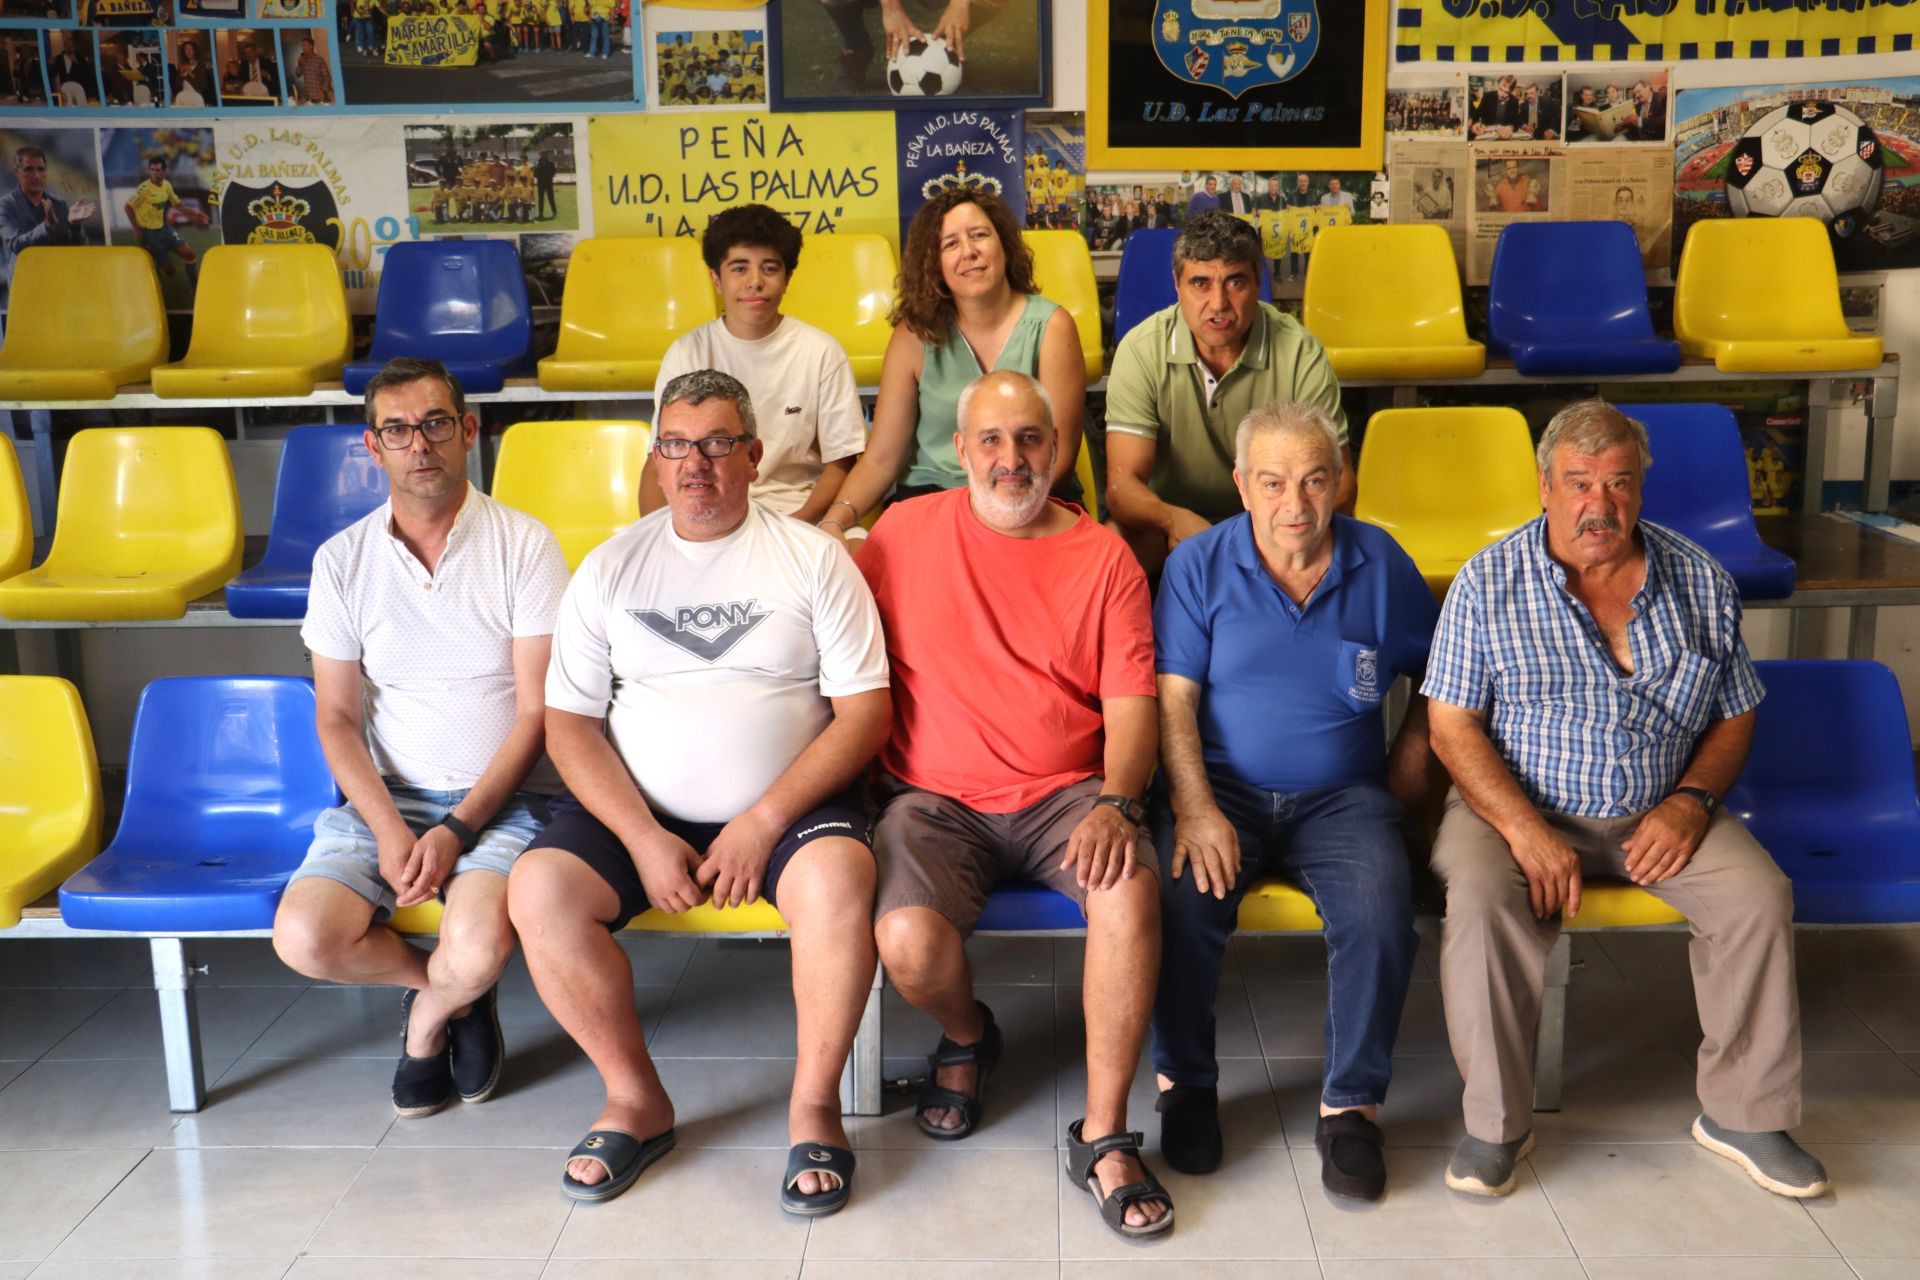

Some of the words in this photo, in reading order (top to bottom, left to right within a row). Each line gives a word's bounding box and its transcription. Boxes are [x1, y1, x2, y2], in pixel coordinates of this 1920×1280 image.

[391, 18, 435, 41] MAREA
[411, 30, 476, 58] AMARILLA
[1142, 101, 1190, 122] U.D.
[1197, 101, 1239, 122] Las
[1243, 101, 1326, 122] Palmas
[680, 119, 804, 160] PEÑA
[906, 135, 928, 168] PEÑA
[924, 115, 950, 136] U.D.
[953, 112, 977, 125] LAS
[979, 116, 1016, 164] PALMAS
[926, 144, 942, 157] LA
[945, 141, 995, 157] BAÑEZA
[207, 161, 234, 207] PEÑA
[228, 133, 263, 160] U.D.
[268, 127, 303, 146] LAS
[304, 141, 351, 205] PALMAS
[235, 163, 254, 178] LA
[259, 160, 319, 178] BAÑEZA
[608, 173, 671, 206] U.D.
[682, 171, 739, 203] LAS
[750, 166, 879, 201] PALMAS
[374, 216, 421, 241] 01
[675, 599, 758, 632] PONY
